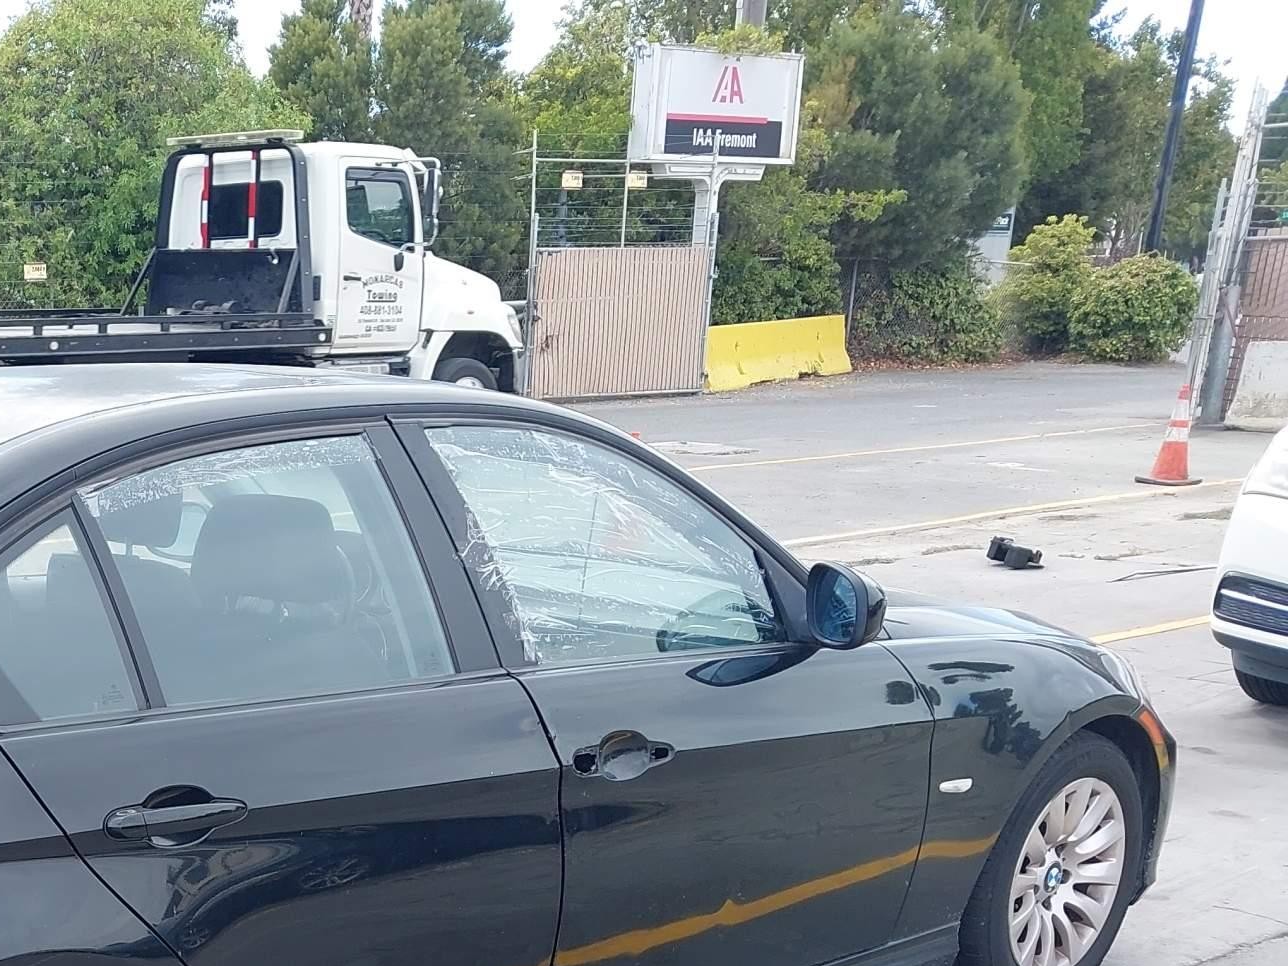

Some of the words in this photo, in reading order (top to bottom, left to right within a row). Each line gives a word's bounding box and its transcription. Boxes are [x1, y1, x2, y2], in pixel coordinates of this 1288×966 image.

[692, 127, 713, 146] IAA
[714, 129, 758, 149] Fremont
[367, 288, 398, 302] Towing
